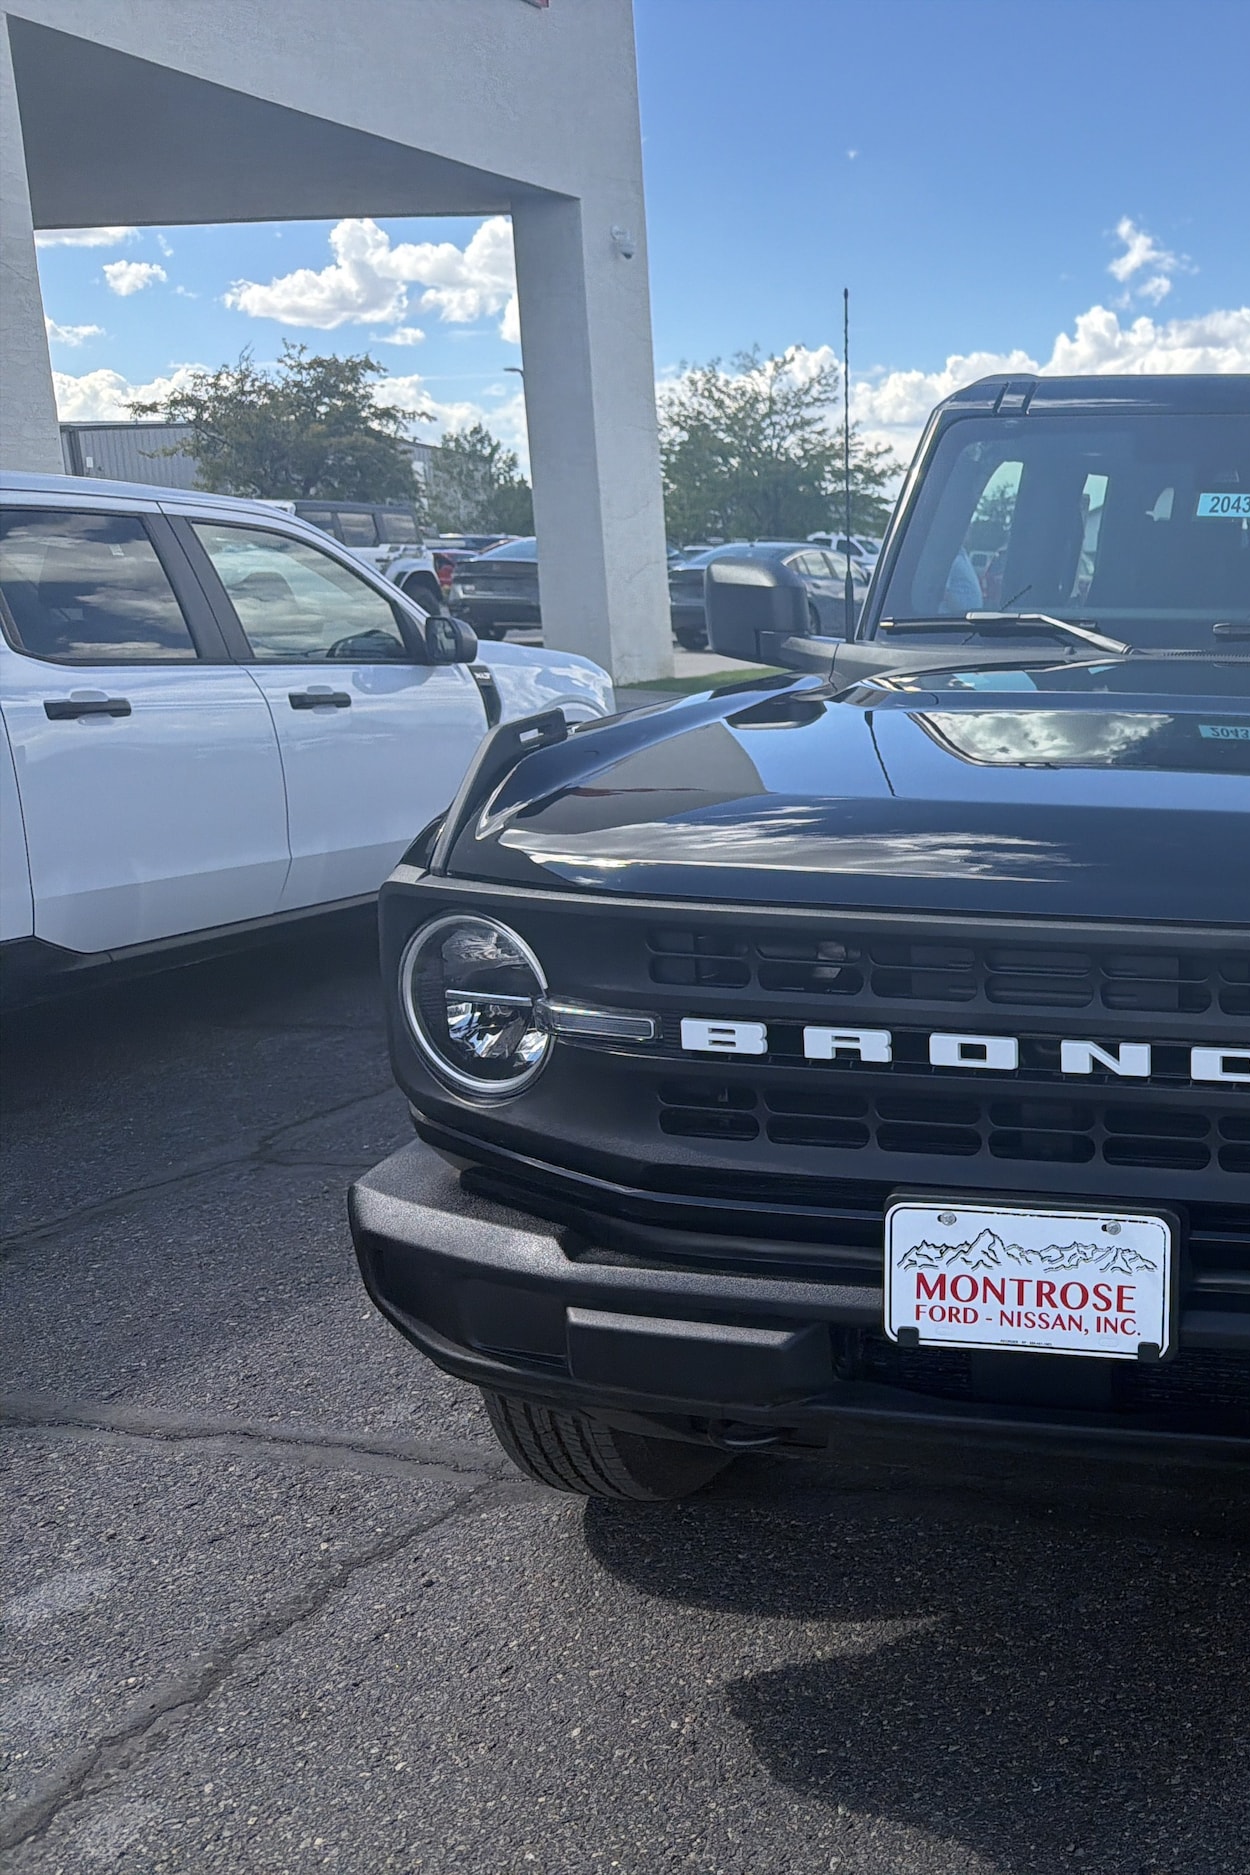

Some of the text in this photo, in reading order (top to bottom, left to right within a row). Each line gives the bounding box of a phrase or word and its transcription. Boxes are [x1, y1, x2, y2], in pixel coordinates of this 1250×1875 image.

[915, 1272, 1136, 1314] MONTROSE
[915, 1304, 979, 1325] FORD
[999, 1310, 1089, 1335] NISSAN,
[1096, 1316, 1141, 1336] INC.
